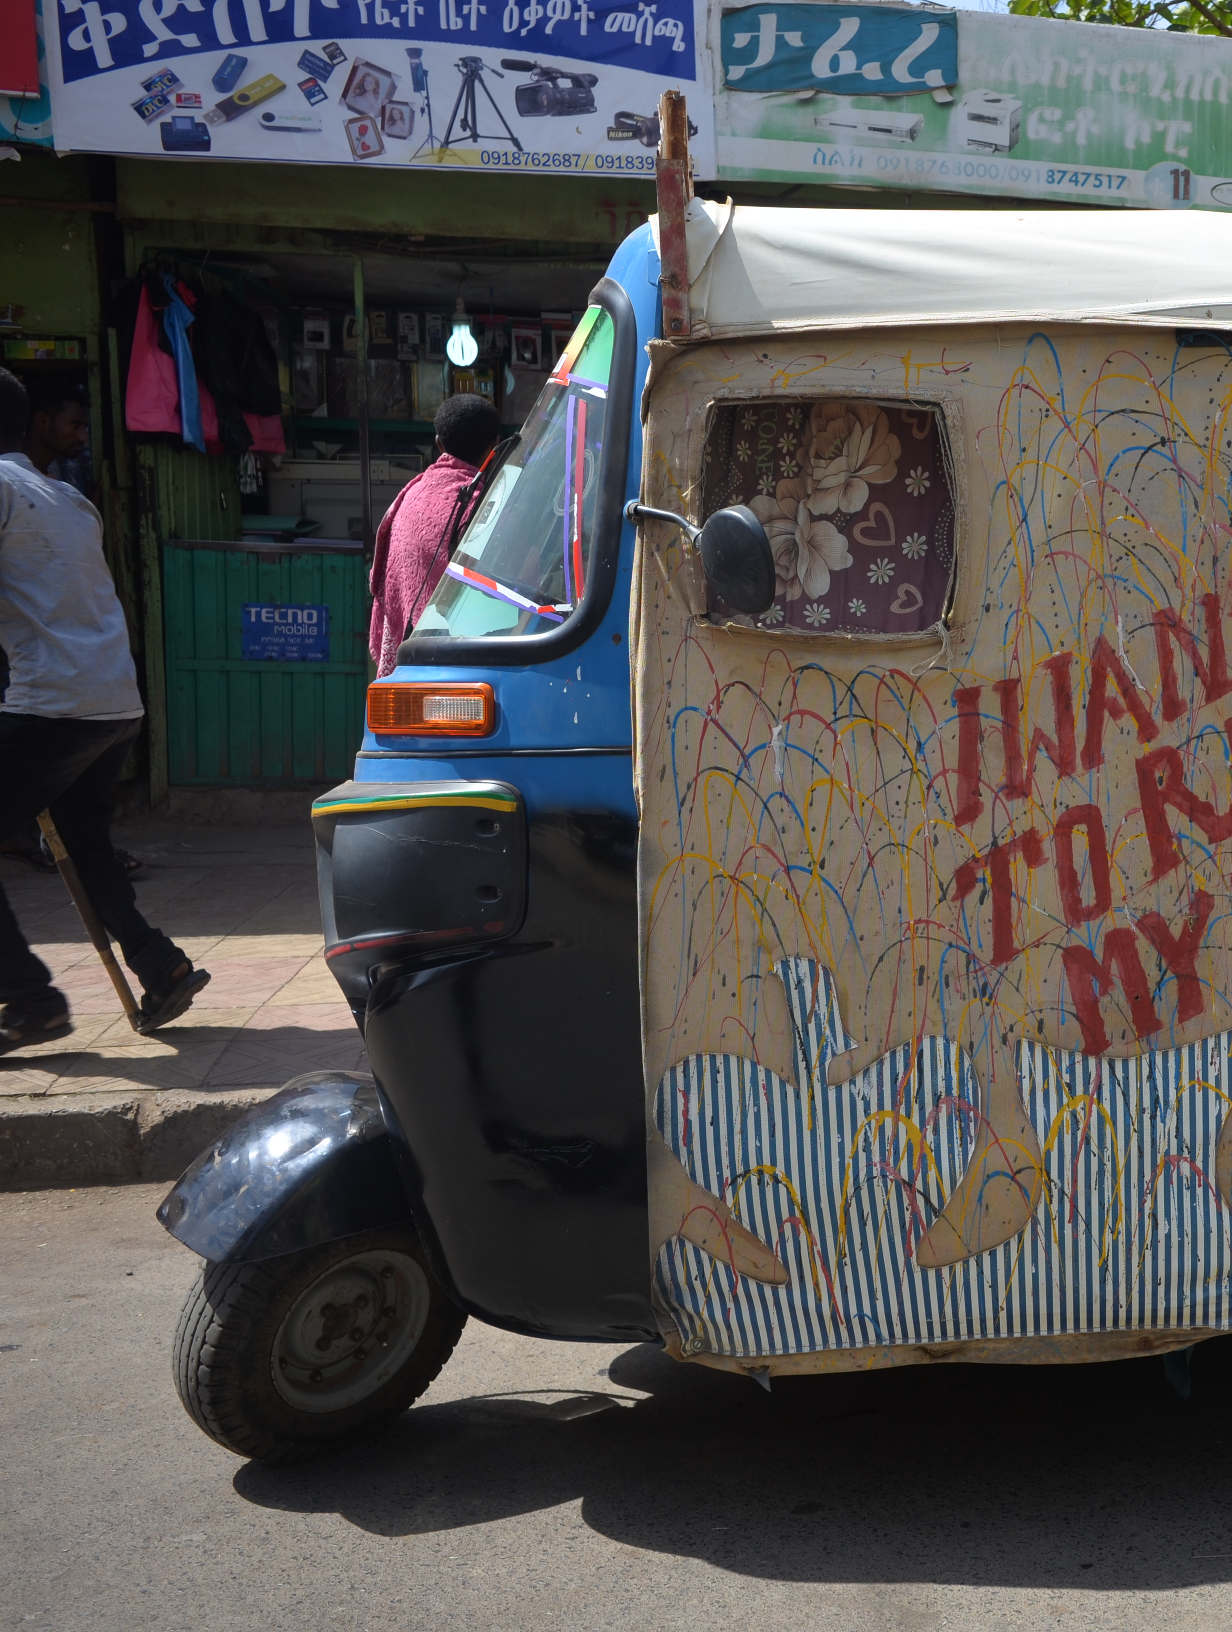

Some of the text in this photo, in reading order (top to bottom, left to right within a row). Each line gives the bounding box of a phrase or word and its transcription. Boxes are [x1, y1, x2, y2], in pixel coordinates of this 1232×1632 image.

[1171, 168, 1191, 201] 11
[245, 607, 318, 624] TECNO
[1061, 890, 1214, 1056] MY
